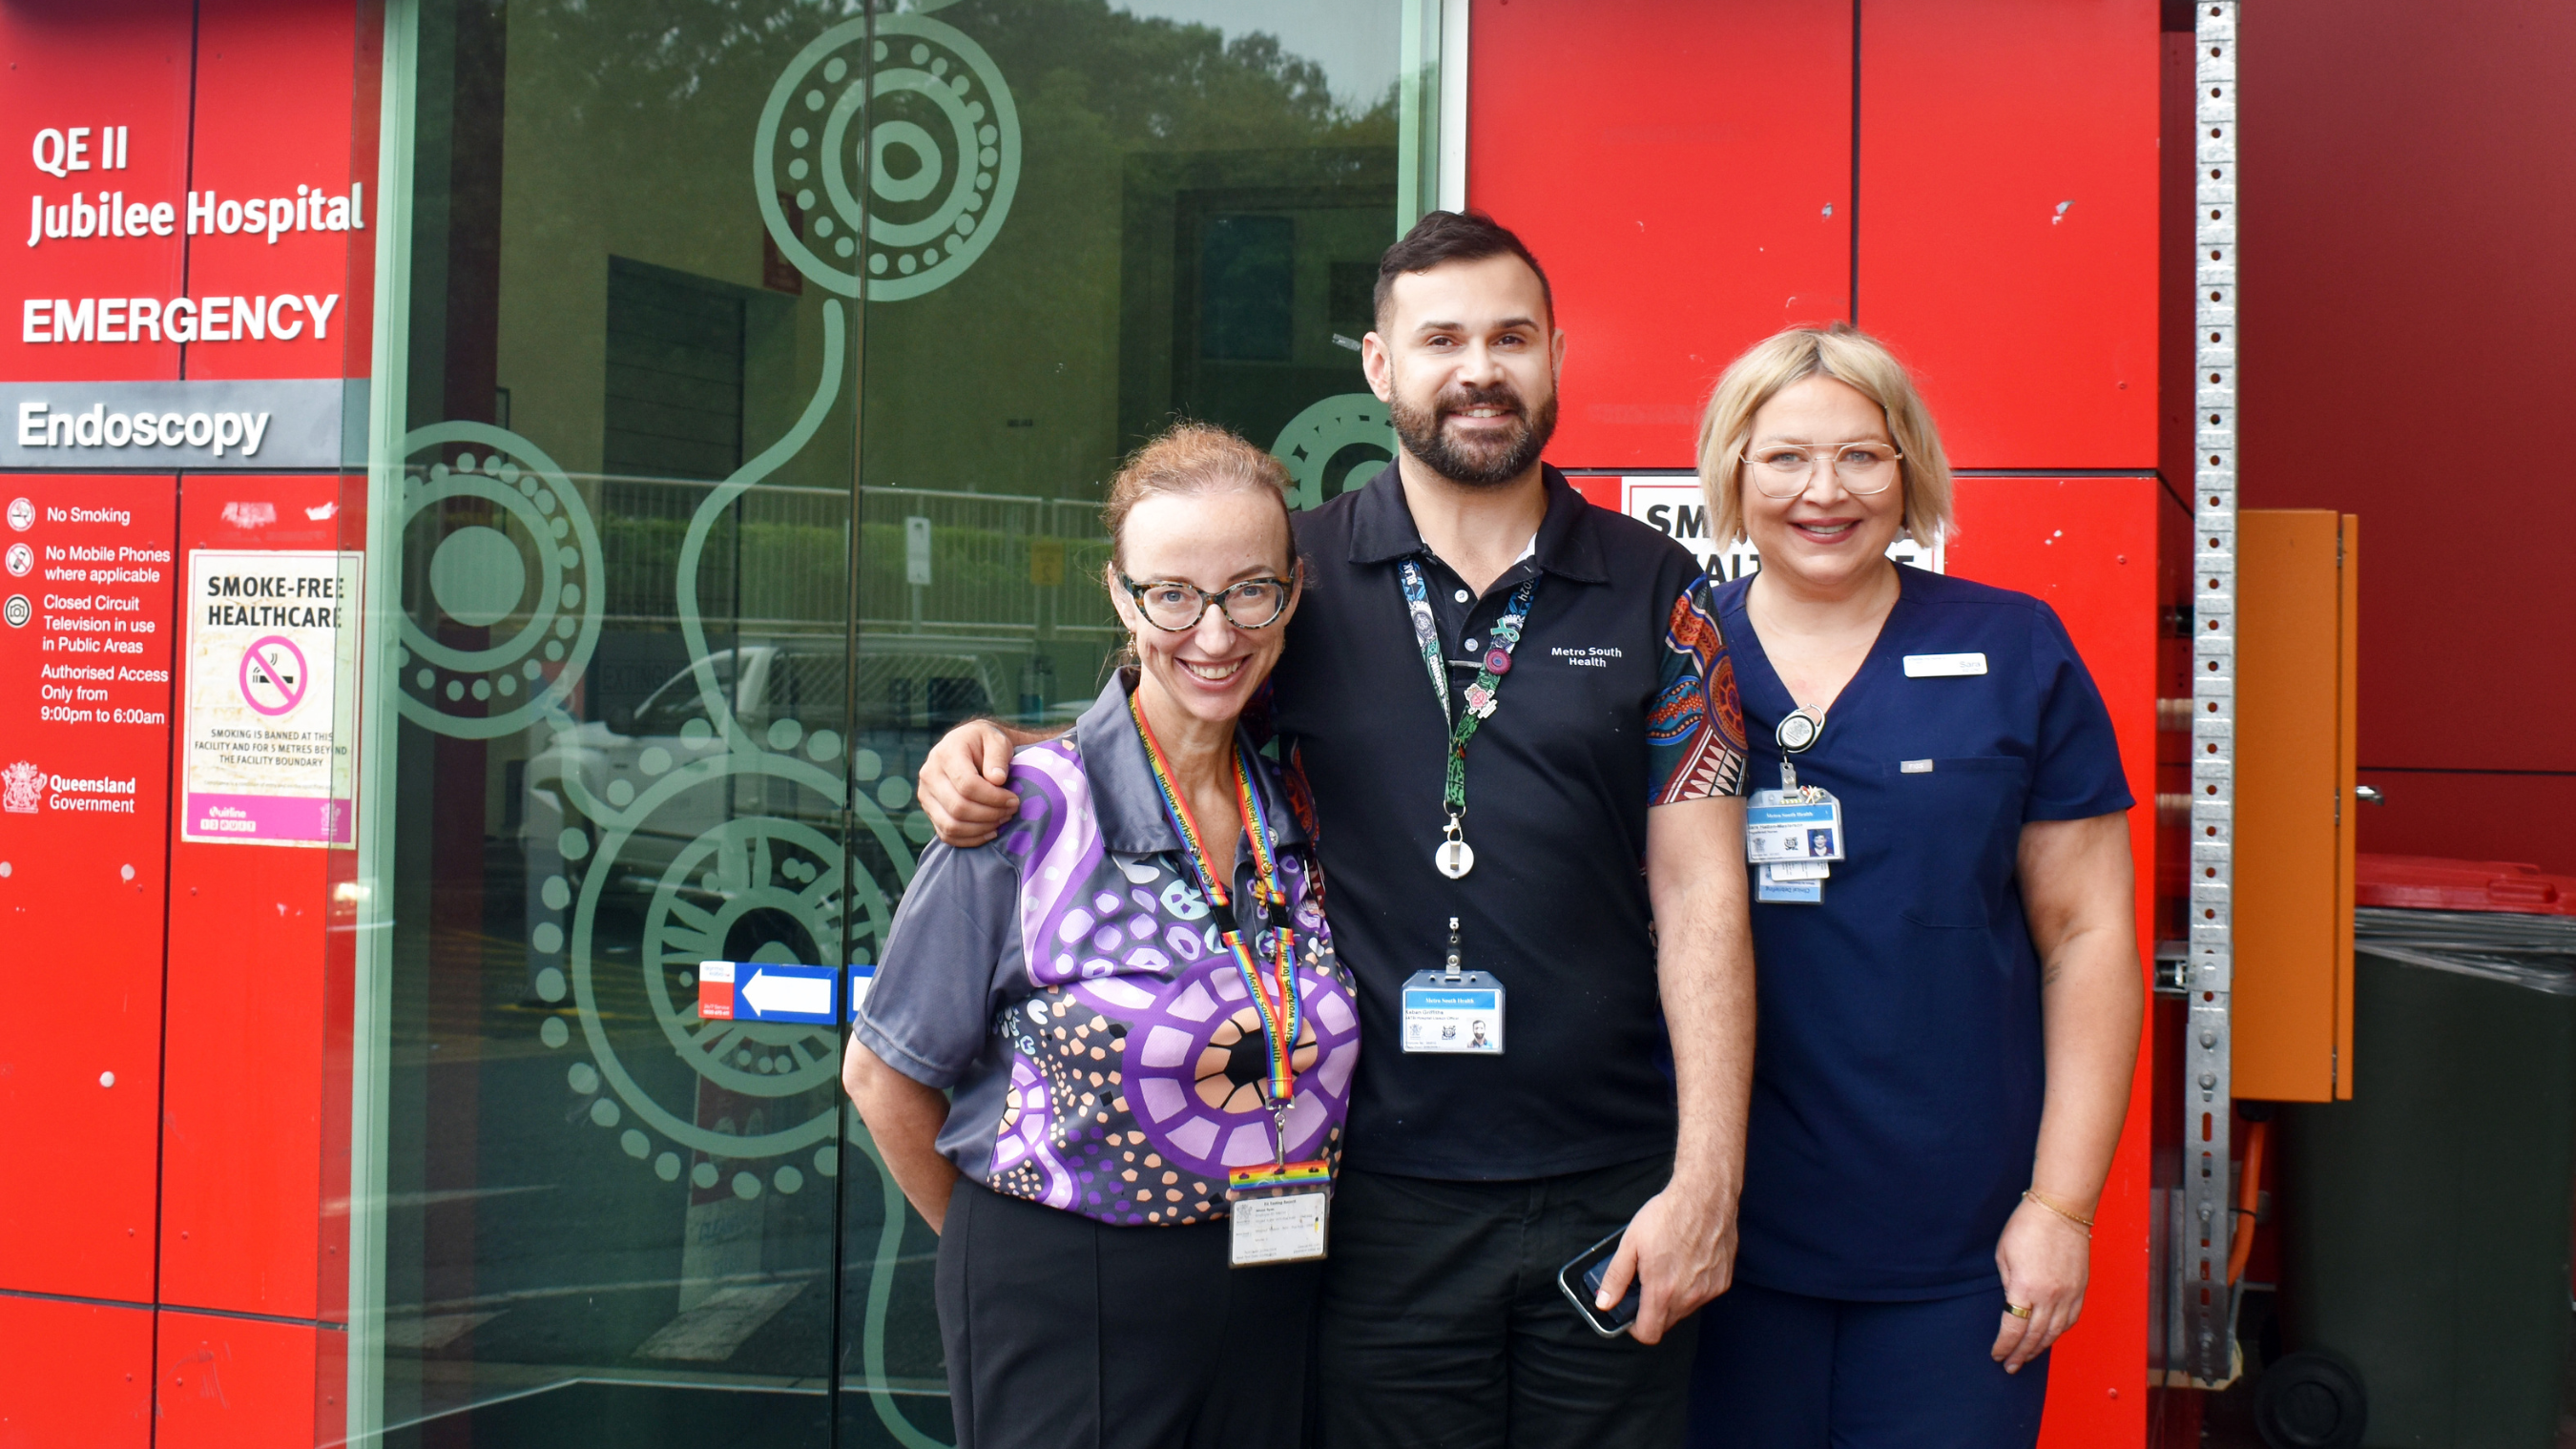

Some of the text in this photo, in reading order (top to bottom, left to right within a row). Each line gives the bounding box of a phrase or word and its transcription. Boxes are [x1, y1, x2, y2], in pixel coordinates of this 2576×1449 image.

[32, 126, 127, 177] QE II
[27, 182, 364, 248] Jubilee Hospital
[23, 294, 339, 342] EMERGENCY
[18, 402, 271, 456] Endoscopy
[47, 507, 131, 526] No Smoking
[46, 546, 171, 563] No Mobile Phones
[45, 568, 160, 585] where applicable
[207, 576, 344, 599] SMOKE-FREE
[43, 593, 140, 611] Closed Circuit
[44, 615, 156, 633] Television in use
[207, 605, 342, 629] HEALTHCARE
[43, 636, 143, 653] in Public Areas
[1551, 646, 1622, 657] Metro South
[1568, 656, 1606, 668] Health
[1959, 660, 1981, 669] Sara
[41, 664, 169, 682] Authorised Access
[42, 684, 108, 703] Only from
[41, 706, 165, 725] 9:00pm to 6:00am
[211, 728, 333, 742] SMOKING IS BANNED AT THIS
[195, 740, 347, 756] FACILITY AND FOR 5 METRES BEYND
[219, 755, 323, 767] THE FACILITY BOUNDARY
[1140, 730, 1157, 763] Health
[1157, 773, 1178, 811] Inclusive
[50, 775, 135, 795] Queensland
[50, 793, 135, 814] Government
[1245, 796, 1258, 823] Health
[1281, 964, 1291, 977] for
[1246, 972, 1282, 1063] Metro South Health
